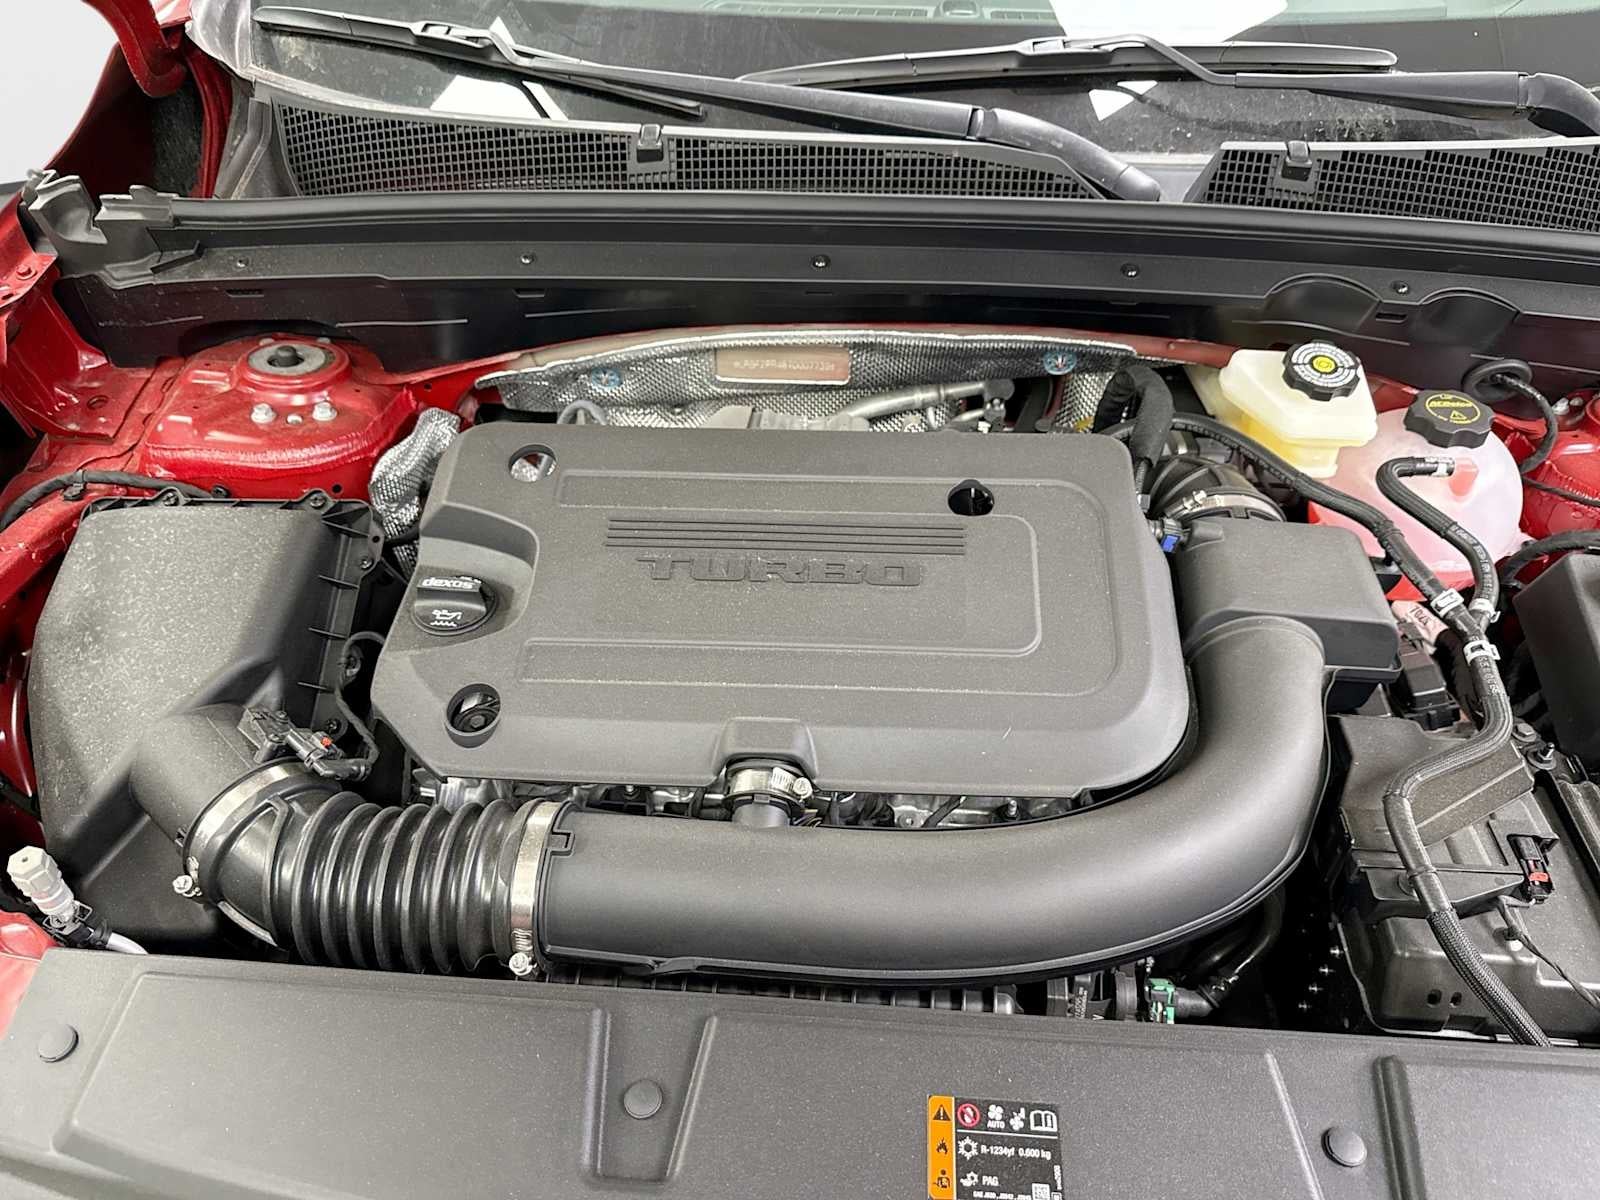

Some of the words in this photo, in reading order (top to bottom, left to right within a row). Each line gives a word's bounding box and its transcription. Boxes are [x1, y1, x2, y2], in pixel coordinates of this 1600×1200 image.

[636, 554, 921, 587] TURBO
[422, 577, 473, 589] dexos
[987, 1120, 1005, 1129] AUTO
[980, 1145, 1015, 1158] R-1234yf
[1040, 1148, 1051, 1161] kg
[982, 1175, 999, 1187] PAG
